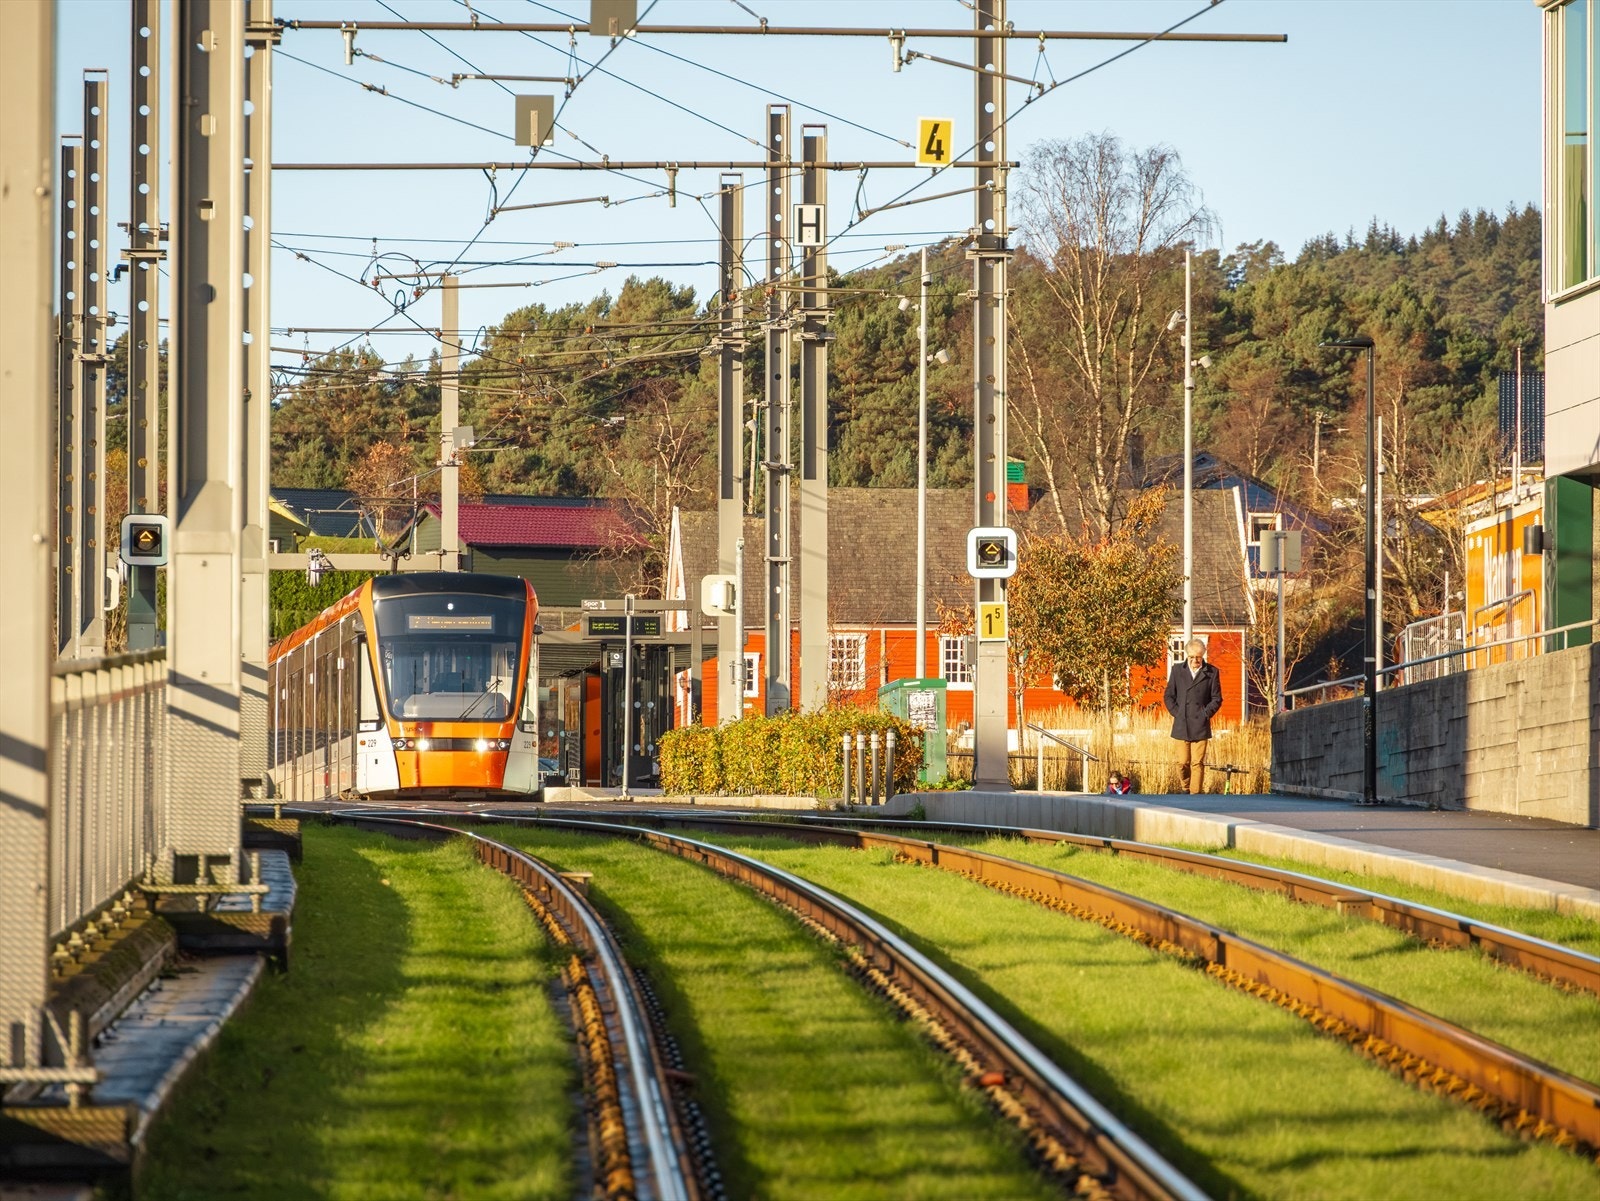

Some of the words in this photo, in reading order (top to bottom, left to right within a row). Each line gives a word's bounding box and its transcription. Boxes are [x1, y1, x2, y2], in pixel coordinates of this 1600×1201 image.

[925, 123, 945, 161] 4
[798, 208, 820, 243] H
[583, 600, 599, 608] Spor
[600, 600, 606, 610] 1
[367, 739, 377, 748] 229
